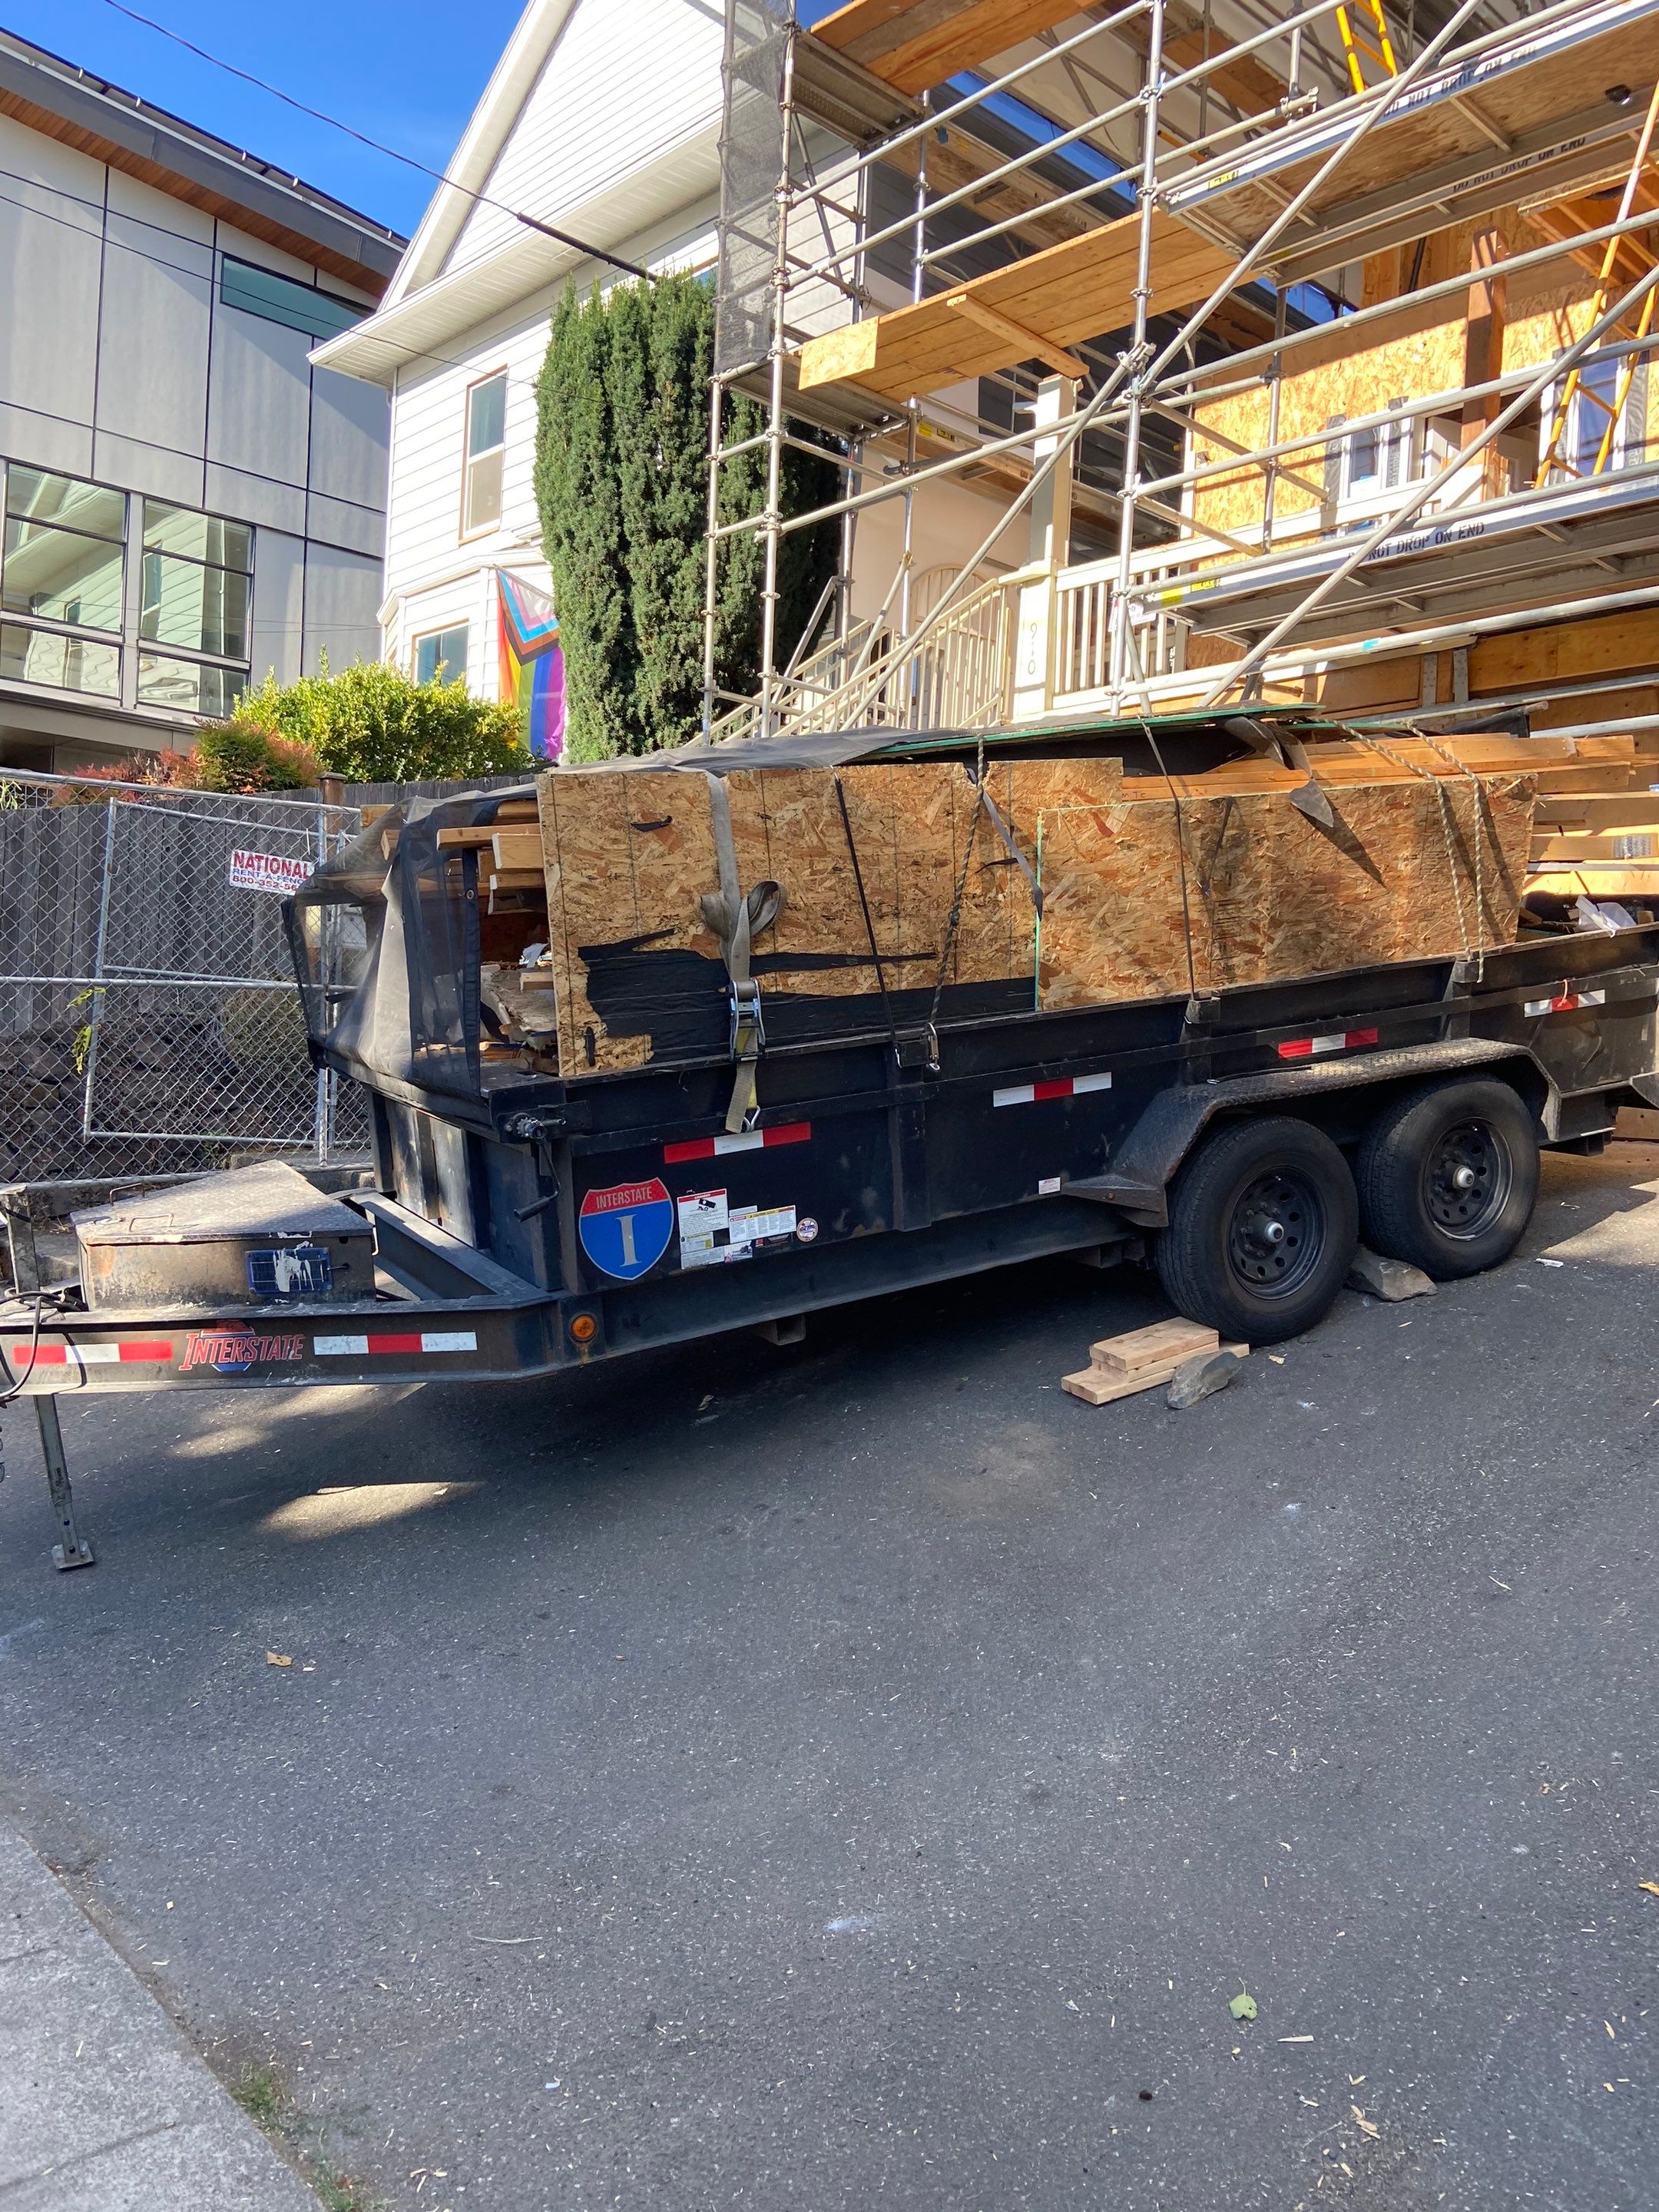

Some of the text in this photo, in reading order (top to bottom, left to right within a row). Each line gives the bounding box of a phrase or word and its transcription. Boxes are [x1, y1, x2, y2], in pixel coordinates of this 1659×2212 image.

[1407, 86, 1432, 108] NOT
[1440, 69, 1475, 94] DROP
[1396, 535, 1430, 554] DROP
[1435, 529, 1452, 545] ON
[1458, 522, 1485, 540] END
[232, 868, 306, 886] RENT-A-FENC
[233, 849, 311, 879] NATIONAL
[232, 876, 298, 891] 800-352-56
[596, 1186, 653, 1210] INTERSTATE
[178, 1333, 306, 1372] INTERSTATE
